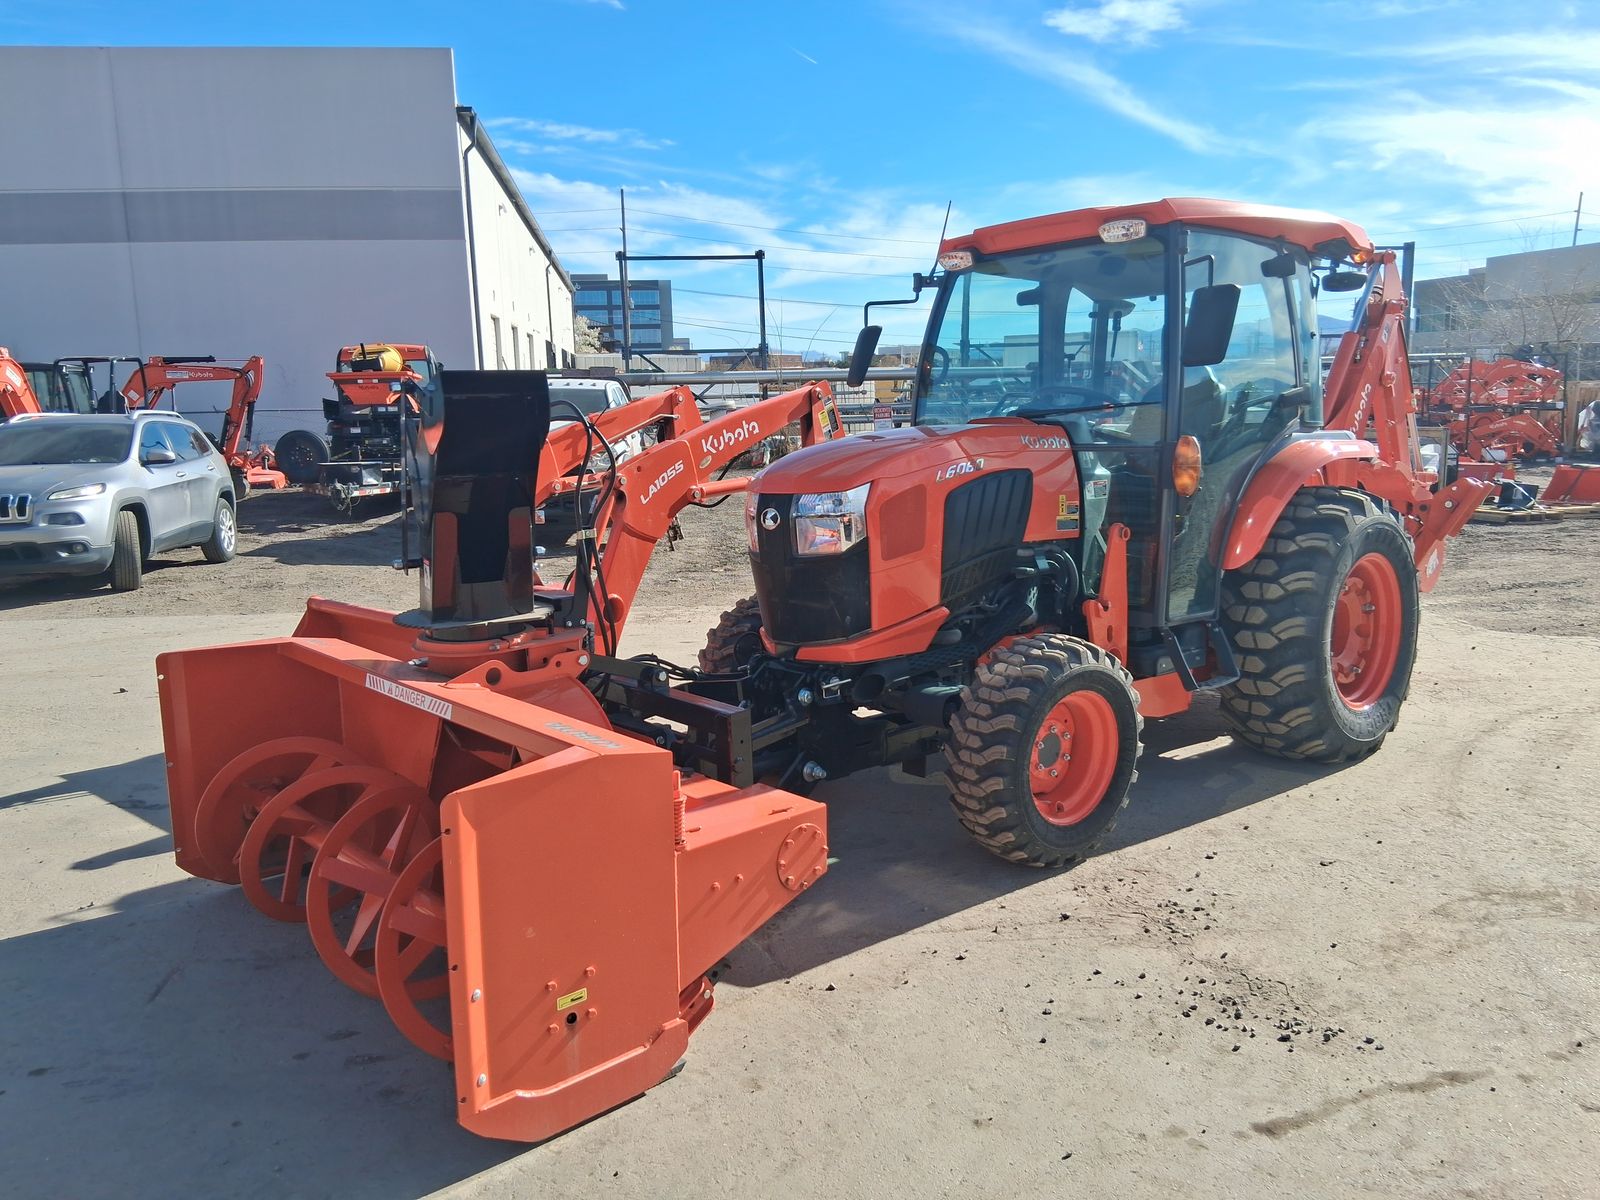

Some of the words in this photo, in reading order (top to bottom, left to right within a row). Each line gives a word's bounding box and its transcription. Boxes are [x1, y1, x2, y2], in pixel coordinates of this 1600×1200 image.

[1351, 383, 1371, 433] ubota
[701, 420, 760, 454] Kubota
[1020, 434, 1070, 449] Kubota
[640, 459, 685, 505] LA1055
[394, 685, 426, 709] DANGER
